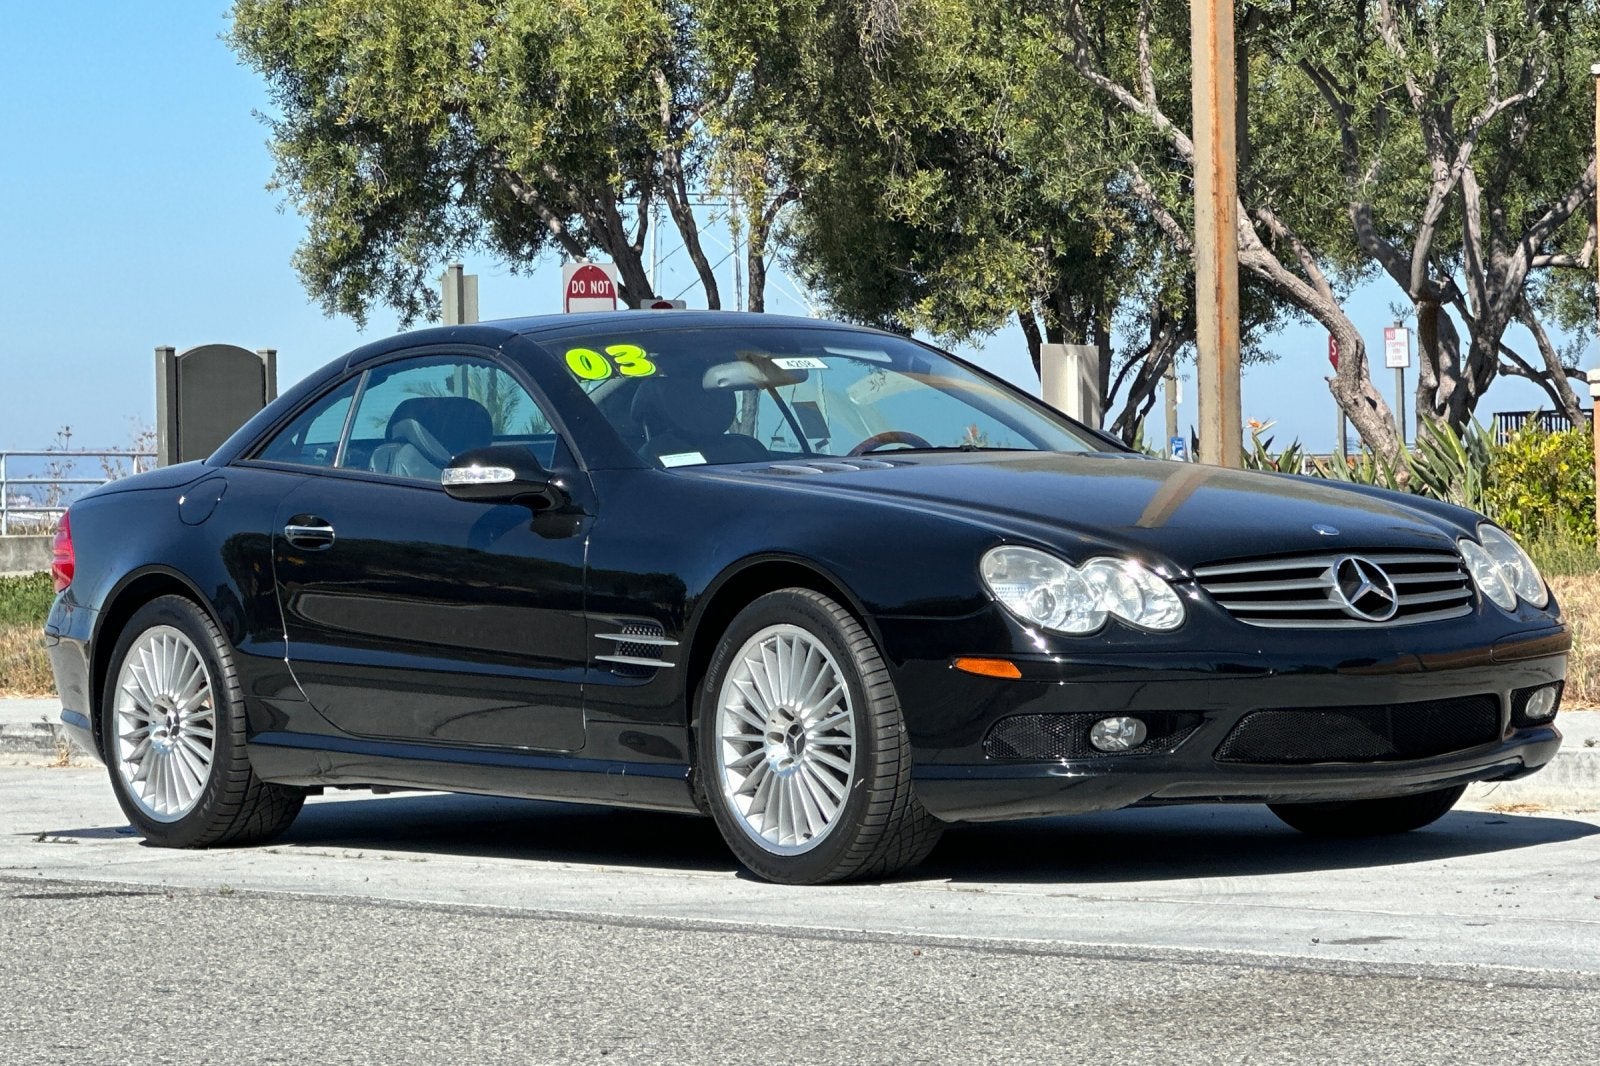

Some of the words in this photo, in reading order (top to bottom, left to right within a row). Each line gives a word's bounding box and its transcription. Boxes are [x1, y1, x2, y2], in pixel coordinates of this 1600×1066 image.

[571, 280, 585, 294] DO
[590, 280, 610, 294] NOT
[1385, 330, 1395, 339] NO
[565, 343, 656, 379] 03
[785, 358, 816, 368] 4208
